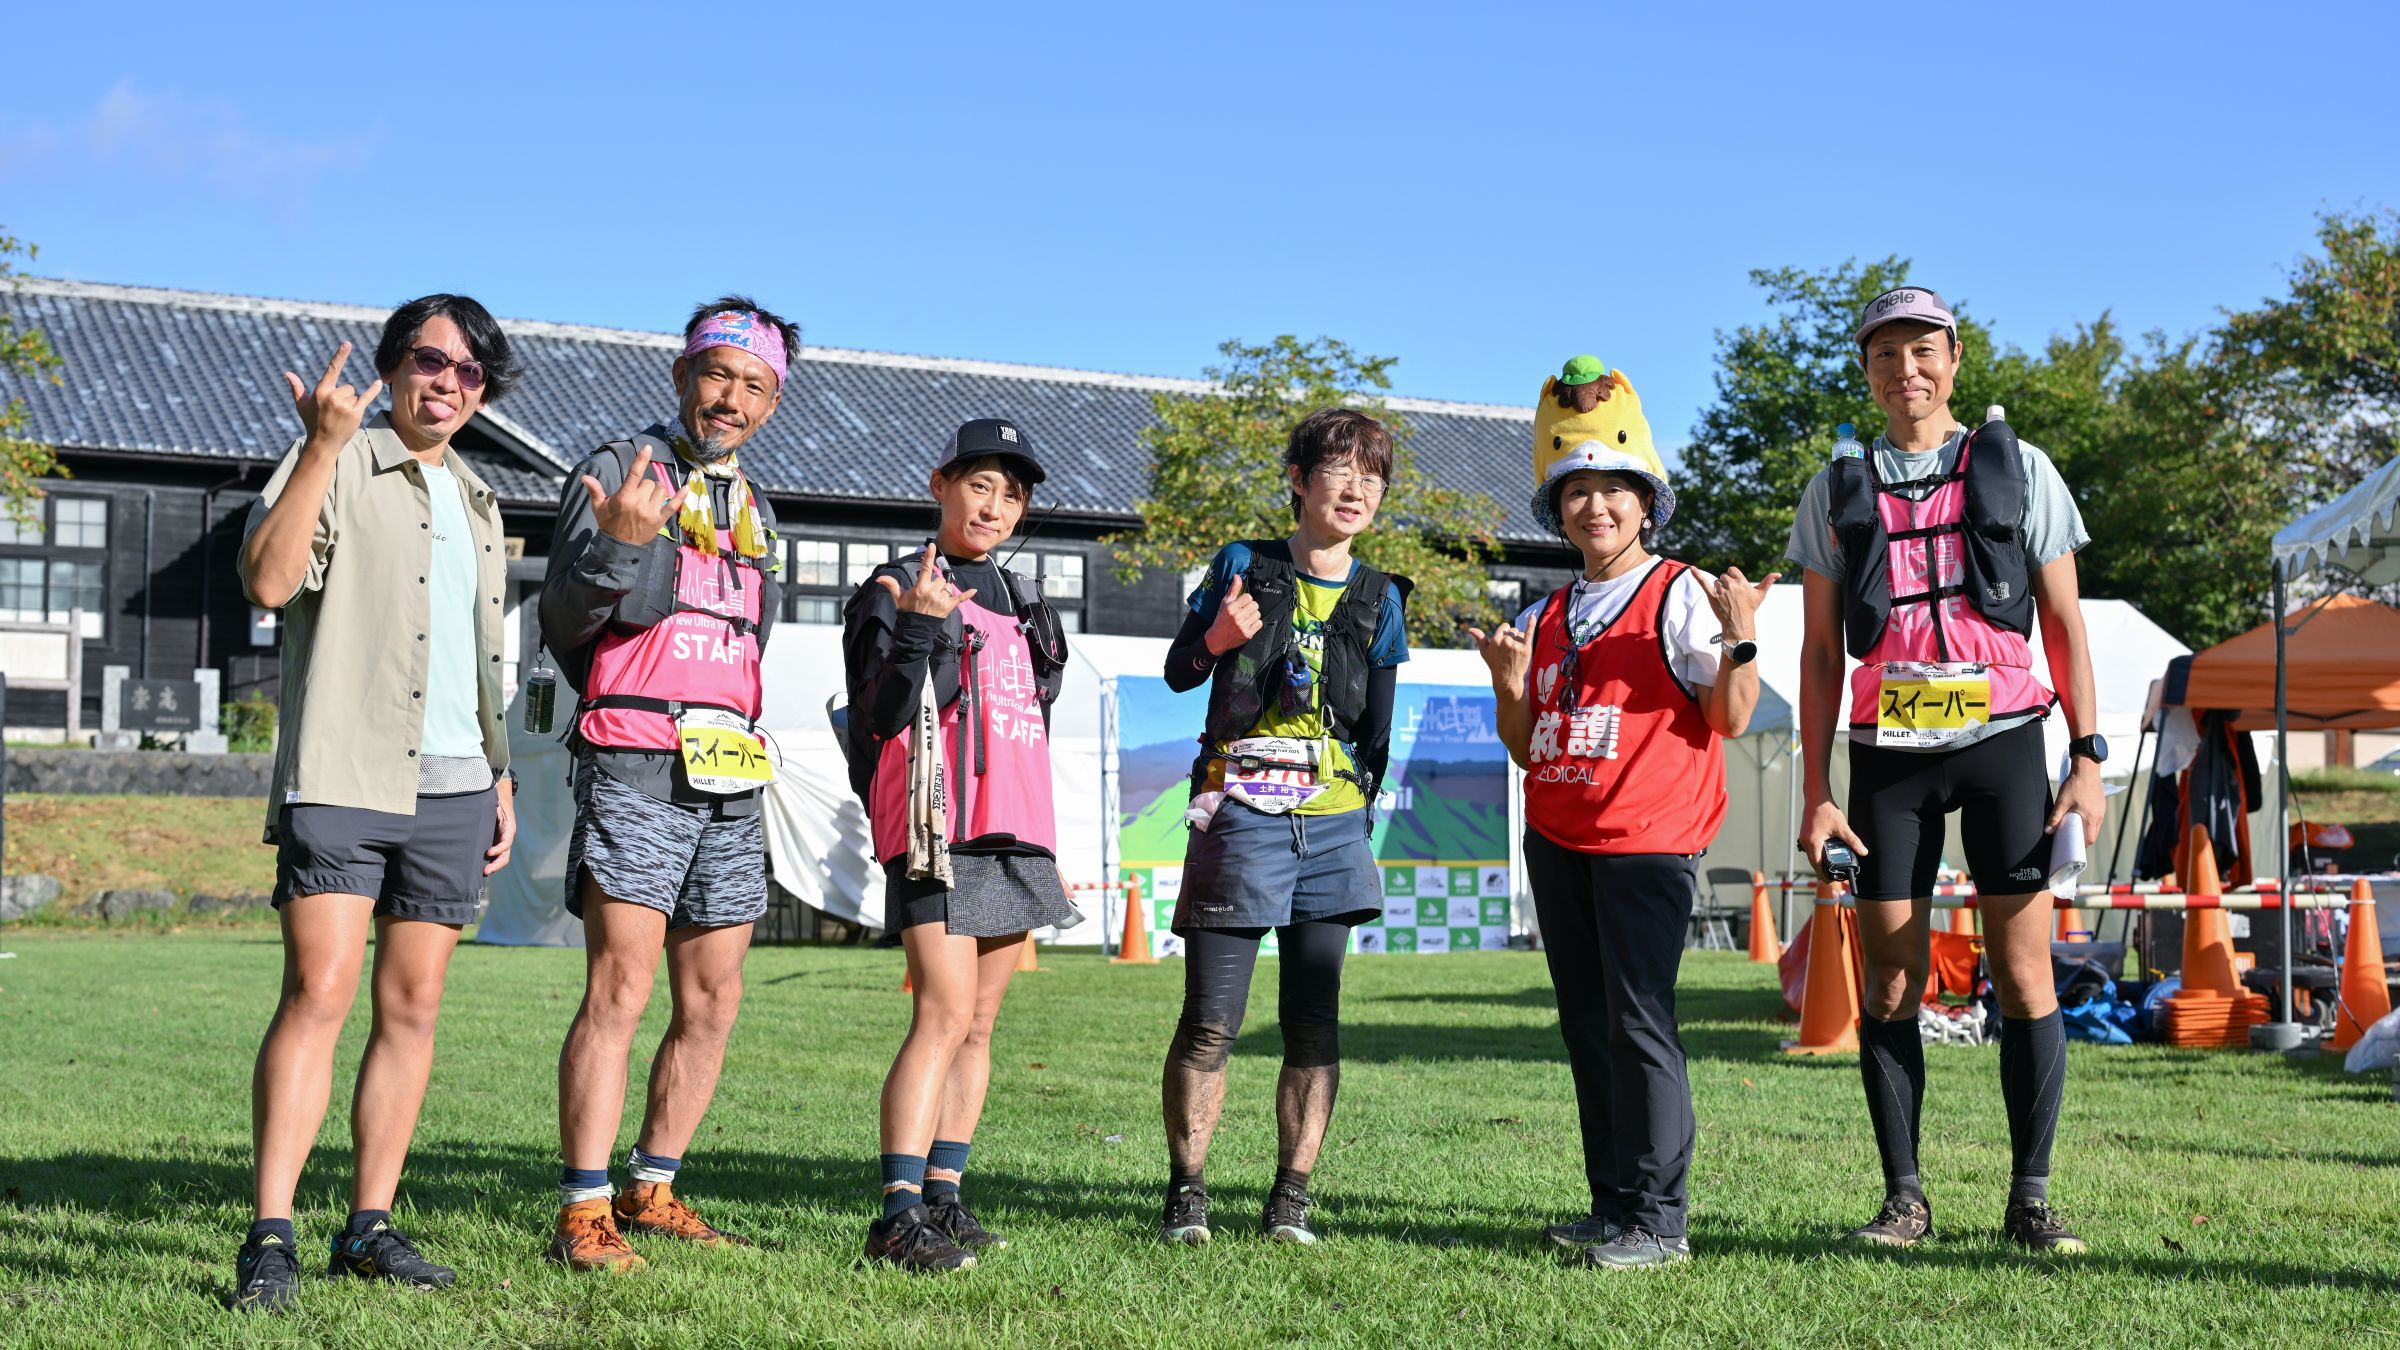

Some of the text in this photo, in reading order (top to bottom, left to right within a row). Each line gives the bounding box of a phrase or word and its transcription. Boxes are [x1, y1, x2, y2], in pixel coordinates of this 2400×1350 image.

[1876, 291, 1915, 313] ciele
[694, 615, 716, 628] Ultra
[1890, 597, 1962, 632] STF
[673, 632, 744, 665] STAF
[1883, 689, 1986, 720] スイーパー
[992, 709, 1043, 749] STAFF
[1530, 704, 1622, 763] 救護
[685, 738, 767, 769] スイーパー
[1259, 785, 1276, 793] 土井
[1537, 765, 1600, 786] EDICAL
[1374, 786, 1413, 811] rail
